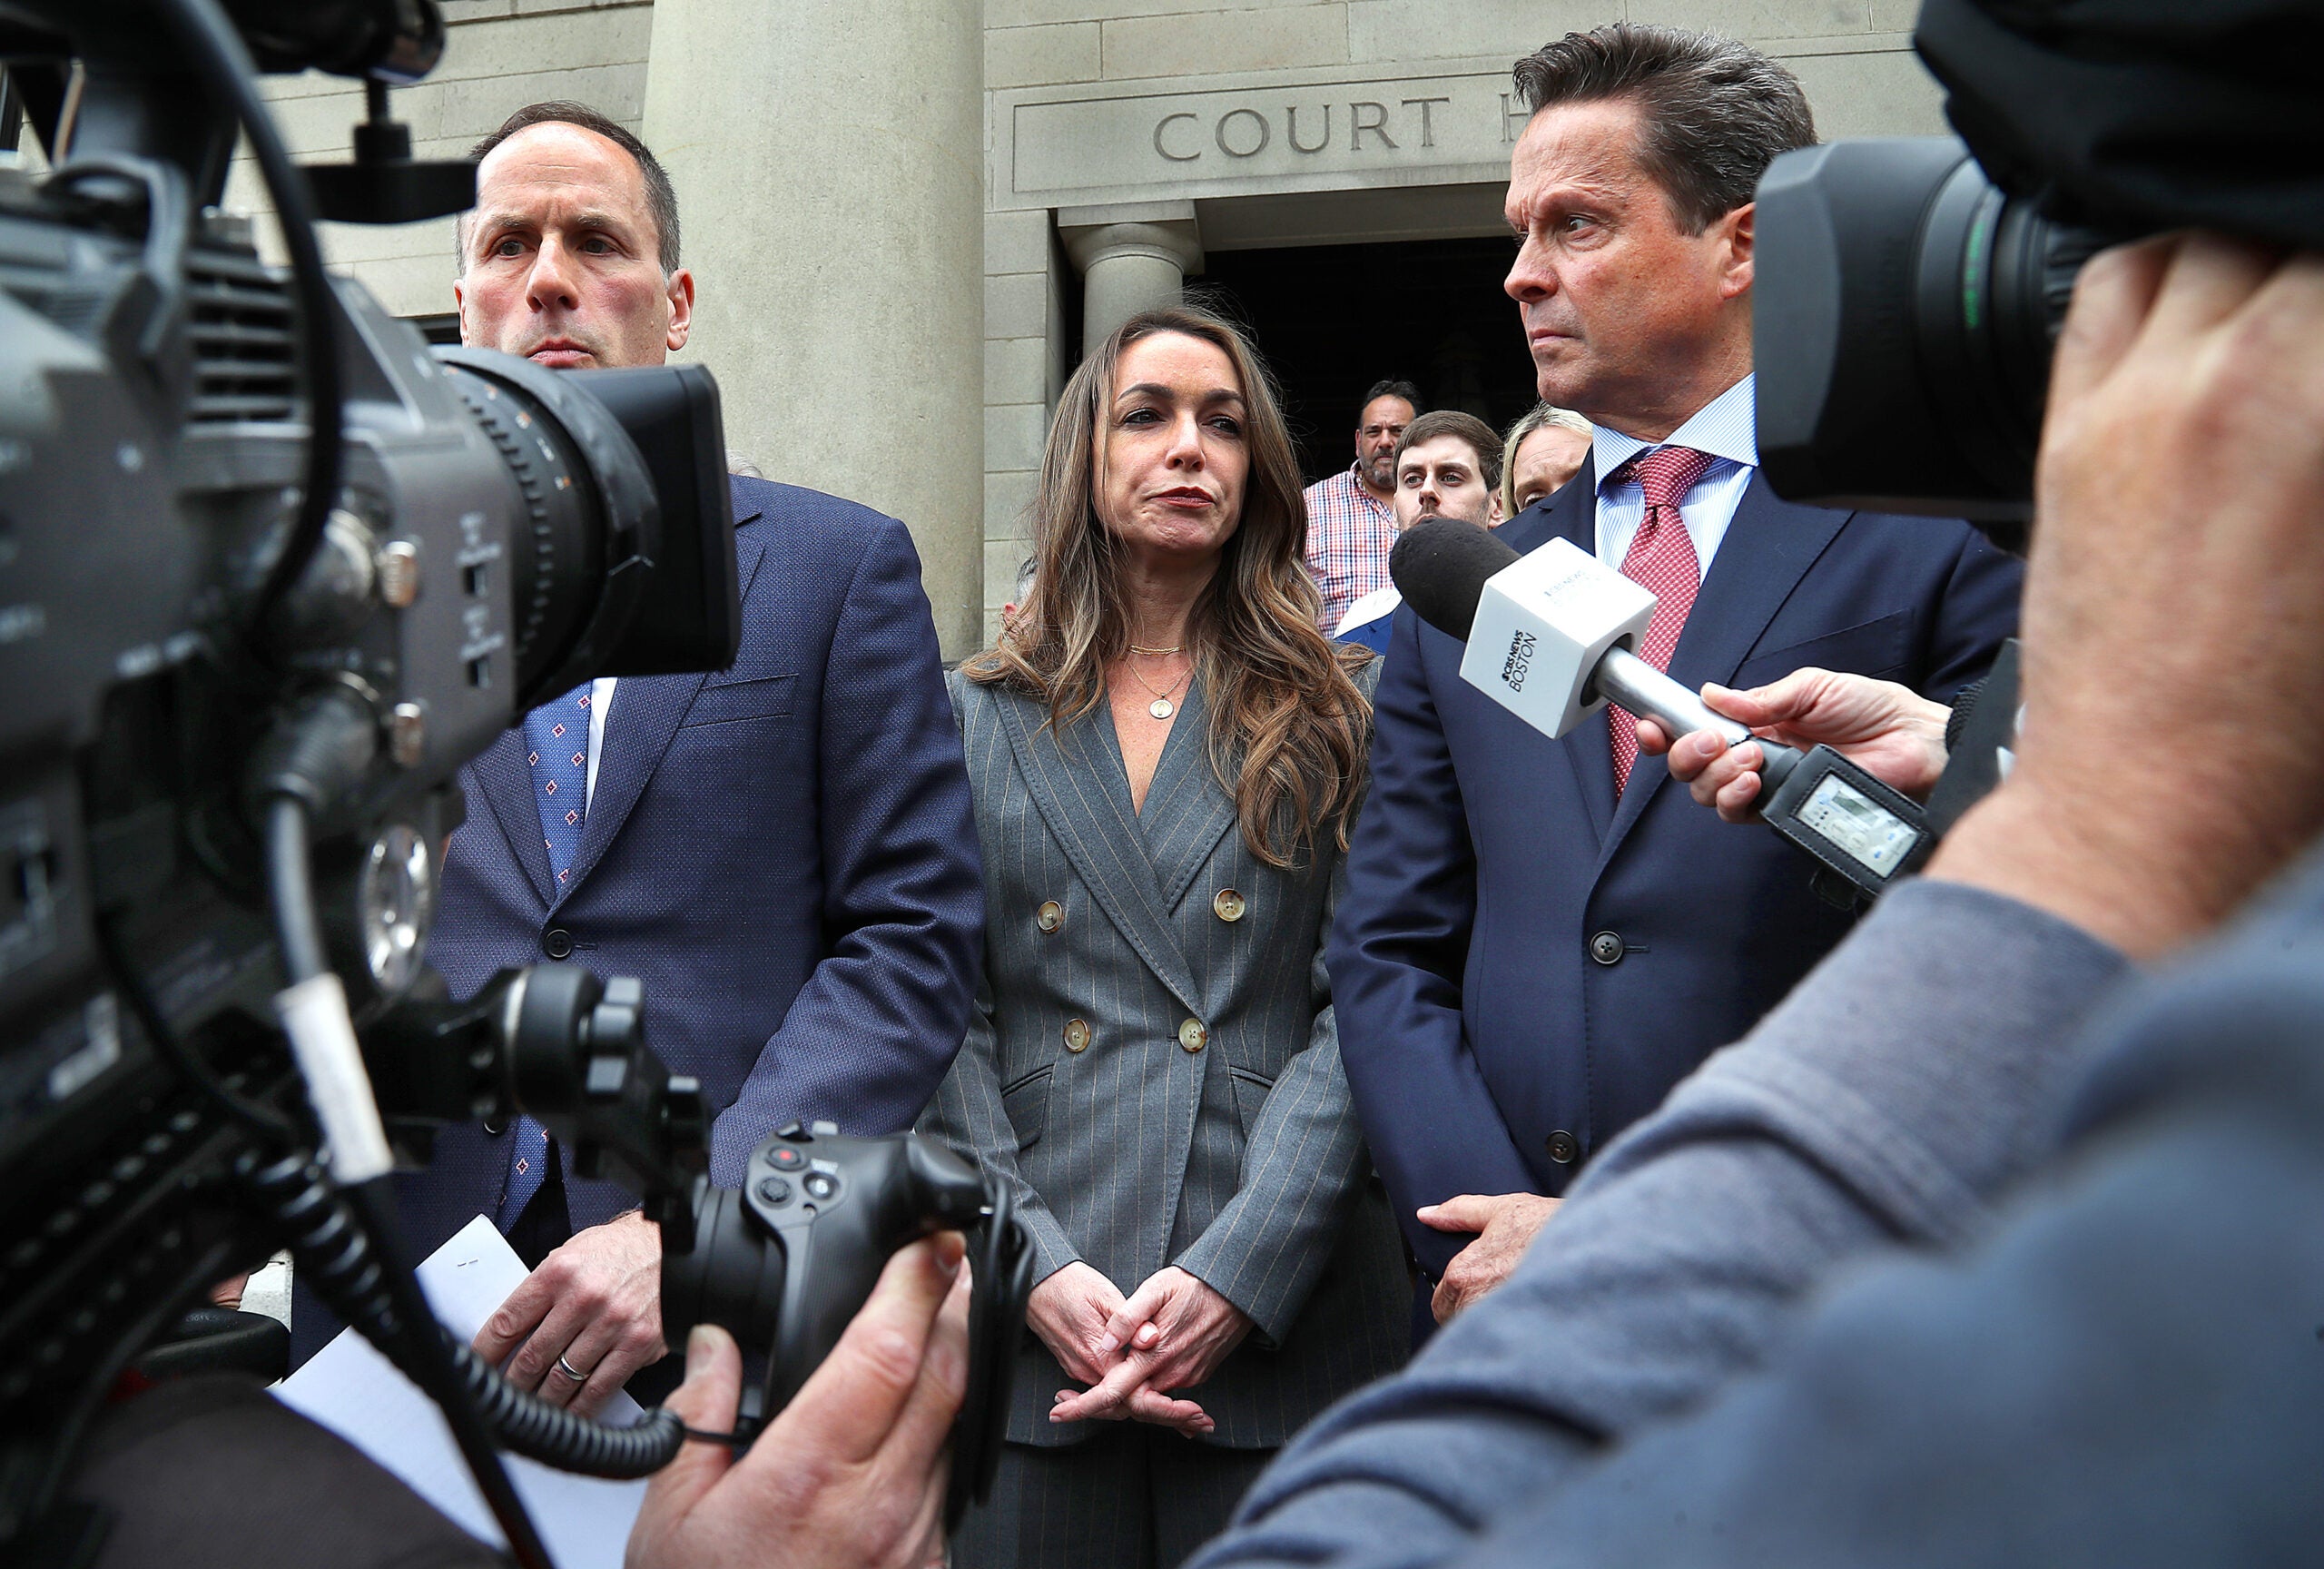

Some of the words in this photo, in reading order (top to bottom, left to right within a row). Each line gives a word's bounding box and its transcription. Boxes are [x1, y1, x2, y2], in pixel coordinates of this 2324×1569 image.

[1153, 97, 1451, 162] COURT
[1504, 656, 1515, 675] CBS
[1509, 629, 1523, 658] NEWS
[1509, 632, 1537, 692] BOSTON
